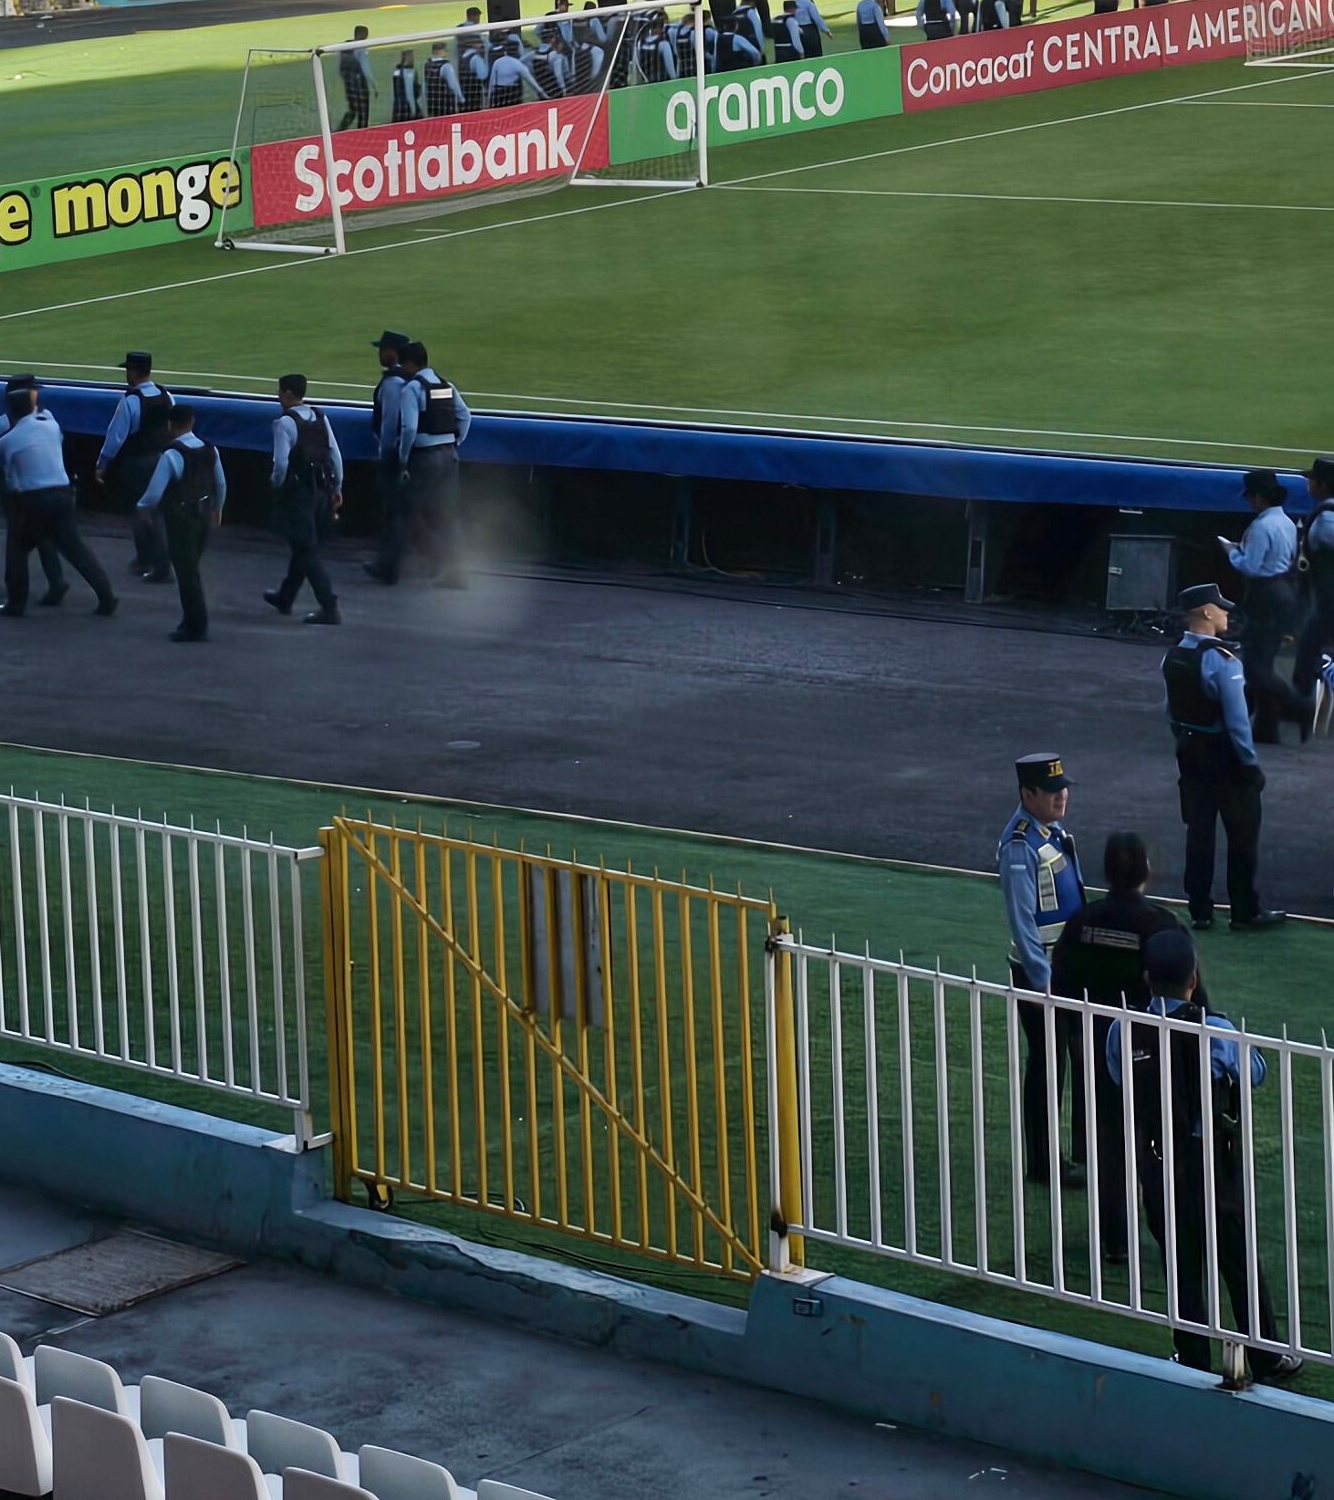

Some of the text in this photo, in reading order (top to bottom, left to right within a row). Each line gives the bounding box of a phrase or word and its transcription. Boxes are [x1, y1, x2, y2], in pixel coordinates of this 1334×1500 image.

[907, 40, 1034, 98] Concacaf
[1043, 19, 1179, 74] CENTRAL
[666, 66, 845, 141] aramco
[52, 158, 243, 233] monge
[294, 107, 575, 213] Scotiabank
